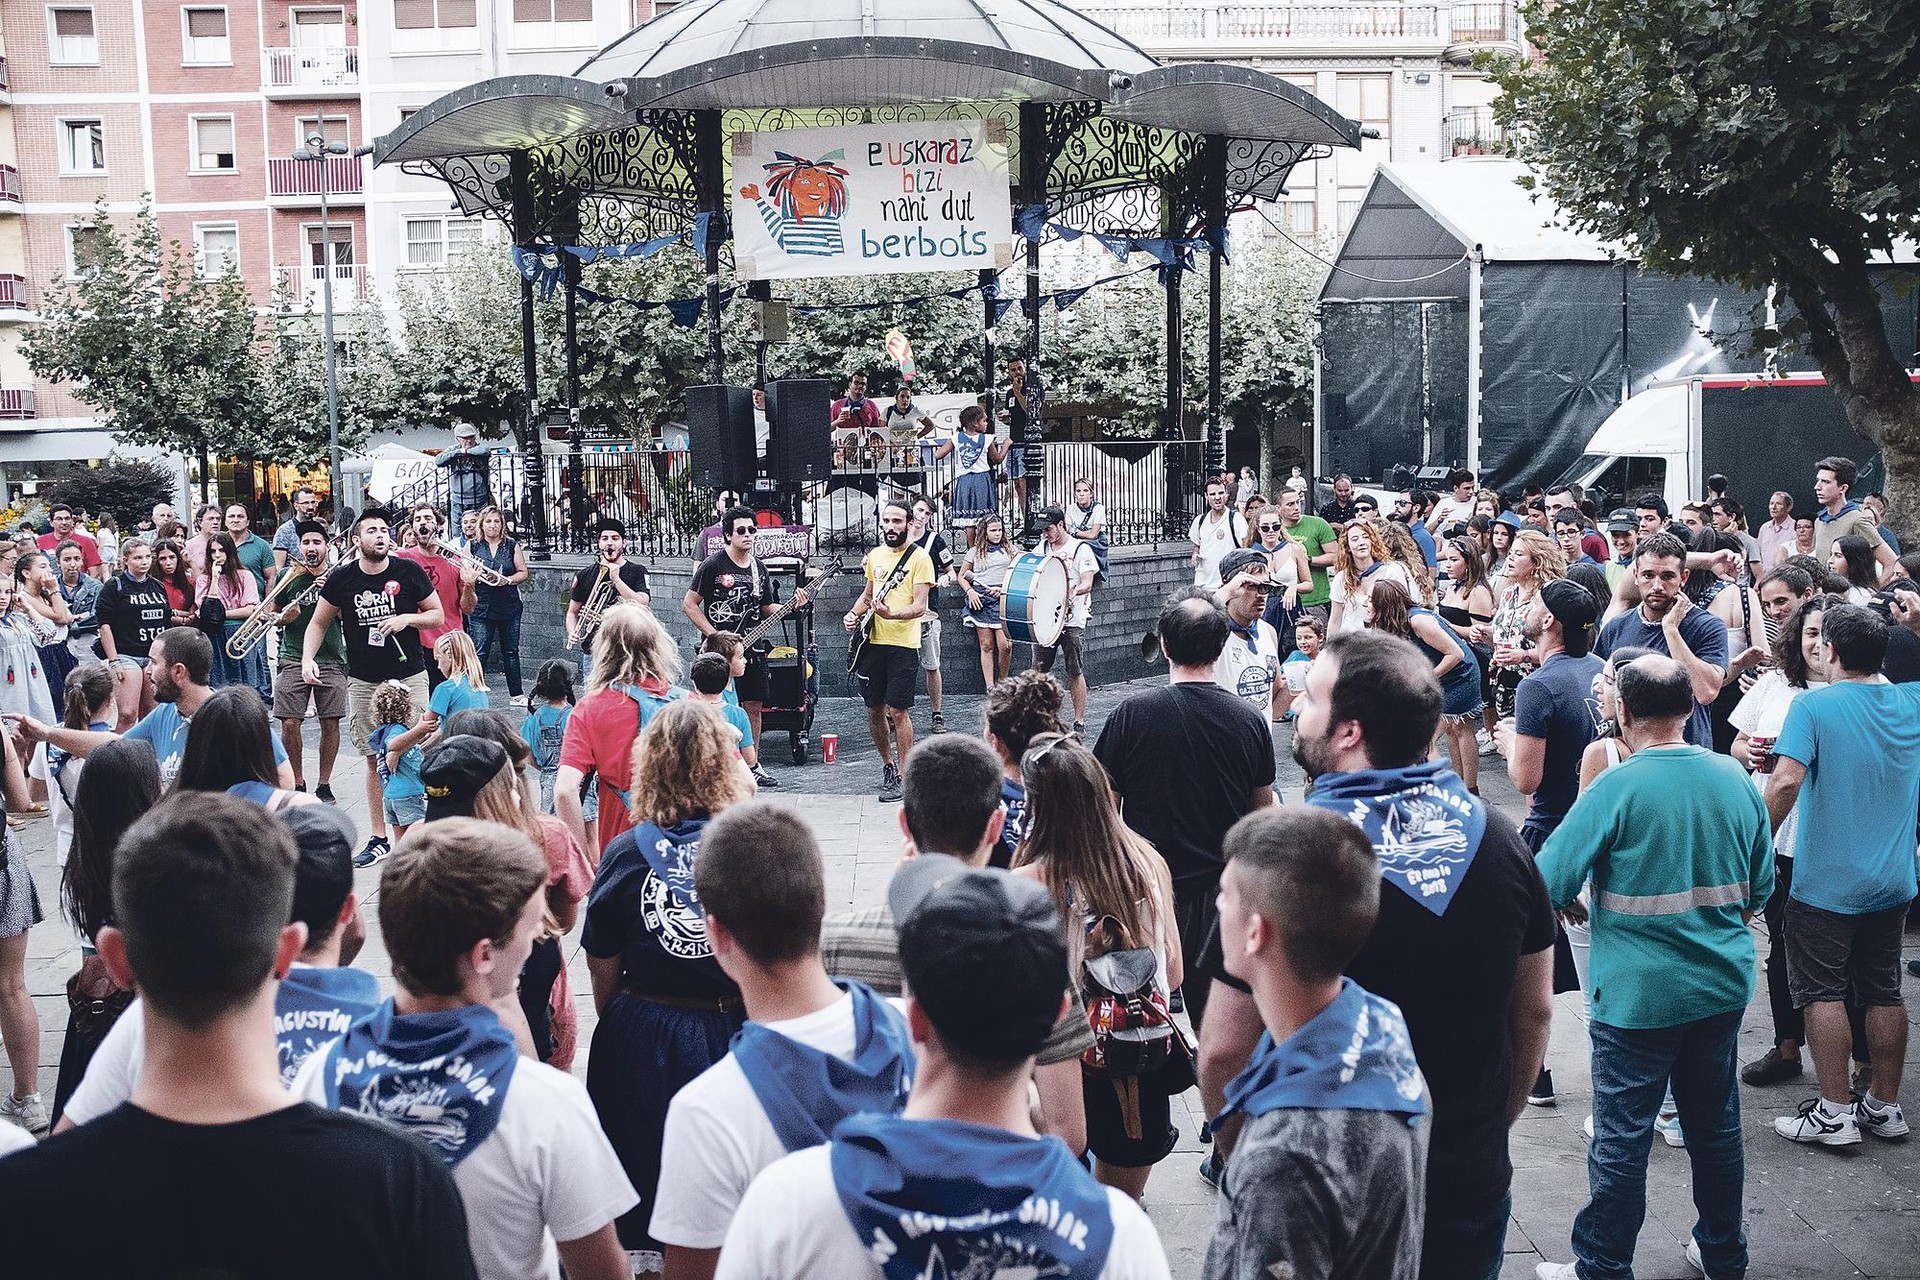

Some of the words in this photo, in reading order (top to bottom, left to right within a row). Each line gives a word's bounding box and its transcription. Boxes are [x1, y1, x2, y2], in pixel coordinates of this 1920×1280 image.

[868, 137, 974, 167] euskaraz
[902, 166, 943, 193] bizi
[880, 195, 929, 222] nahi
[941, 190, 975, 221] dut
[861, 224, 988, 259] berbots
